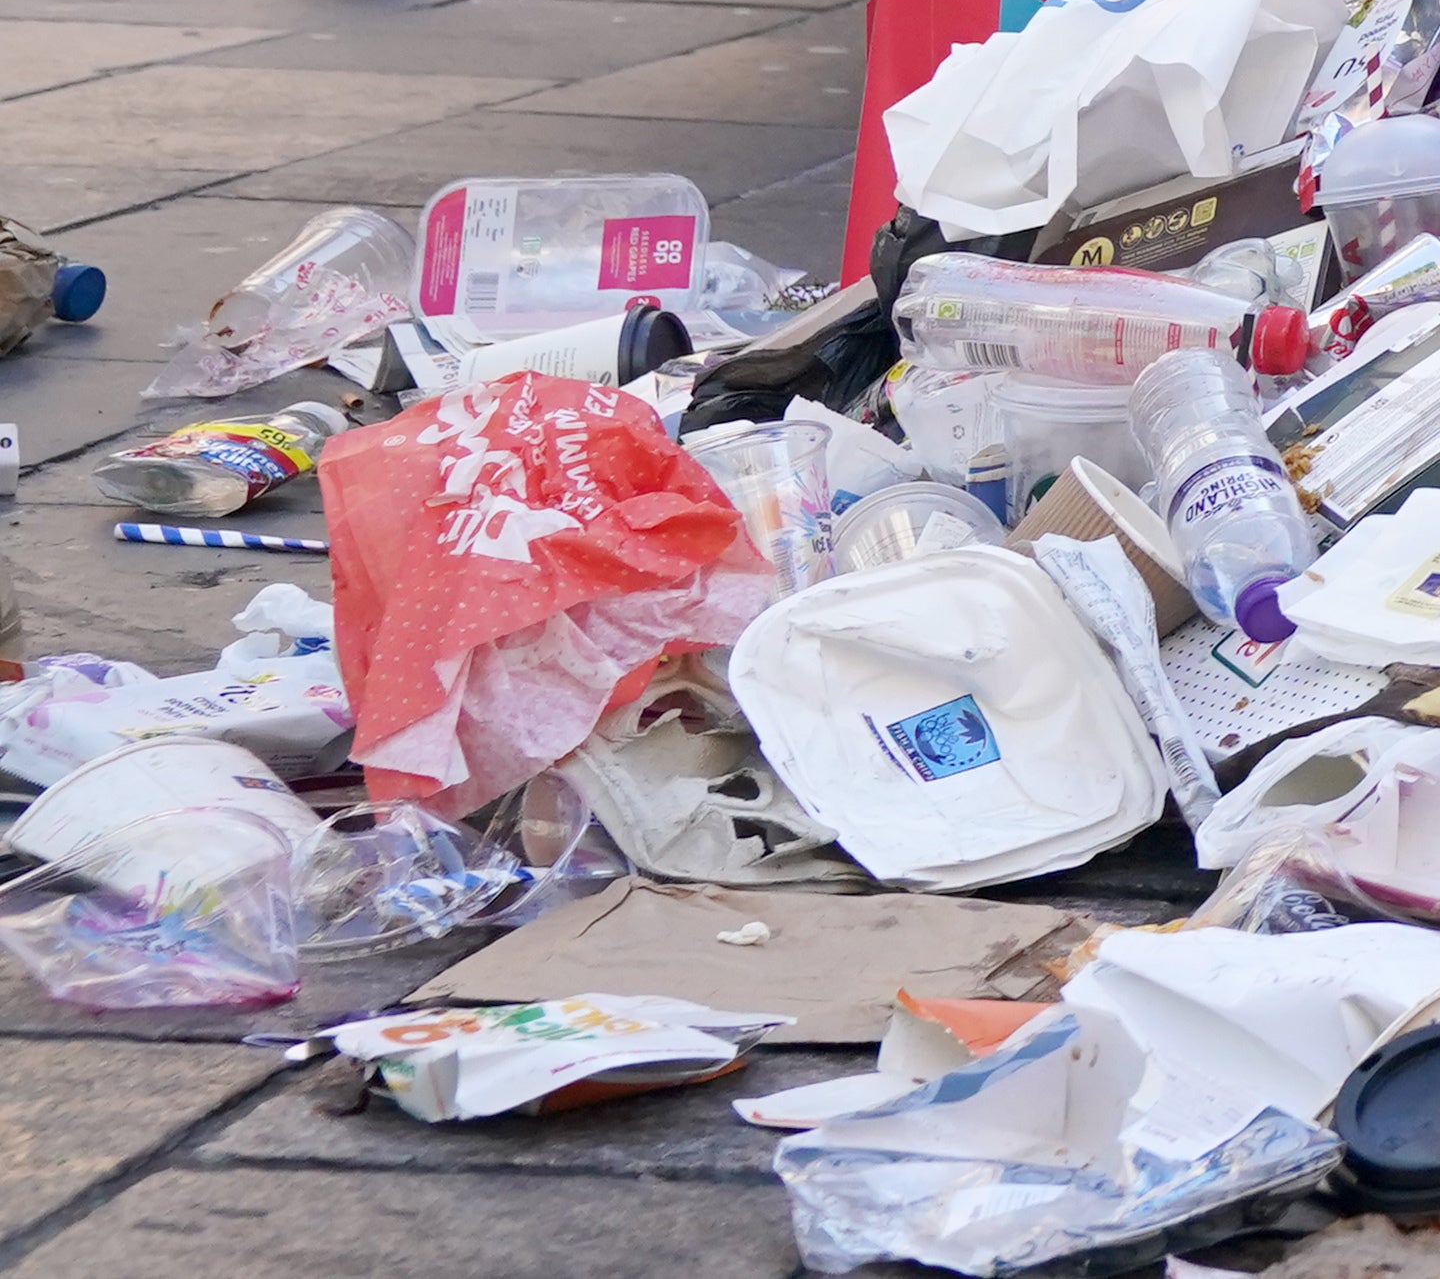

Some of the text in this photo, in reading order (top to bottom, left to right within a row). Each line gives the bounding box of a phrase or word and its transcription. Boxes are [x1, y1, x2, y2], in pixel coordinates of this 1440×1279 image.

[640, 230, 650, 276] SEEDLESS
[668, 239, 683, 264] CO
[1184, 476, 1282, 523] HIGHLAND
[1203, 471, 1257, 498] SPRING
